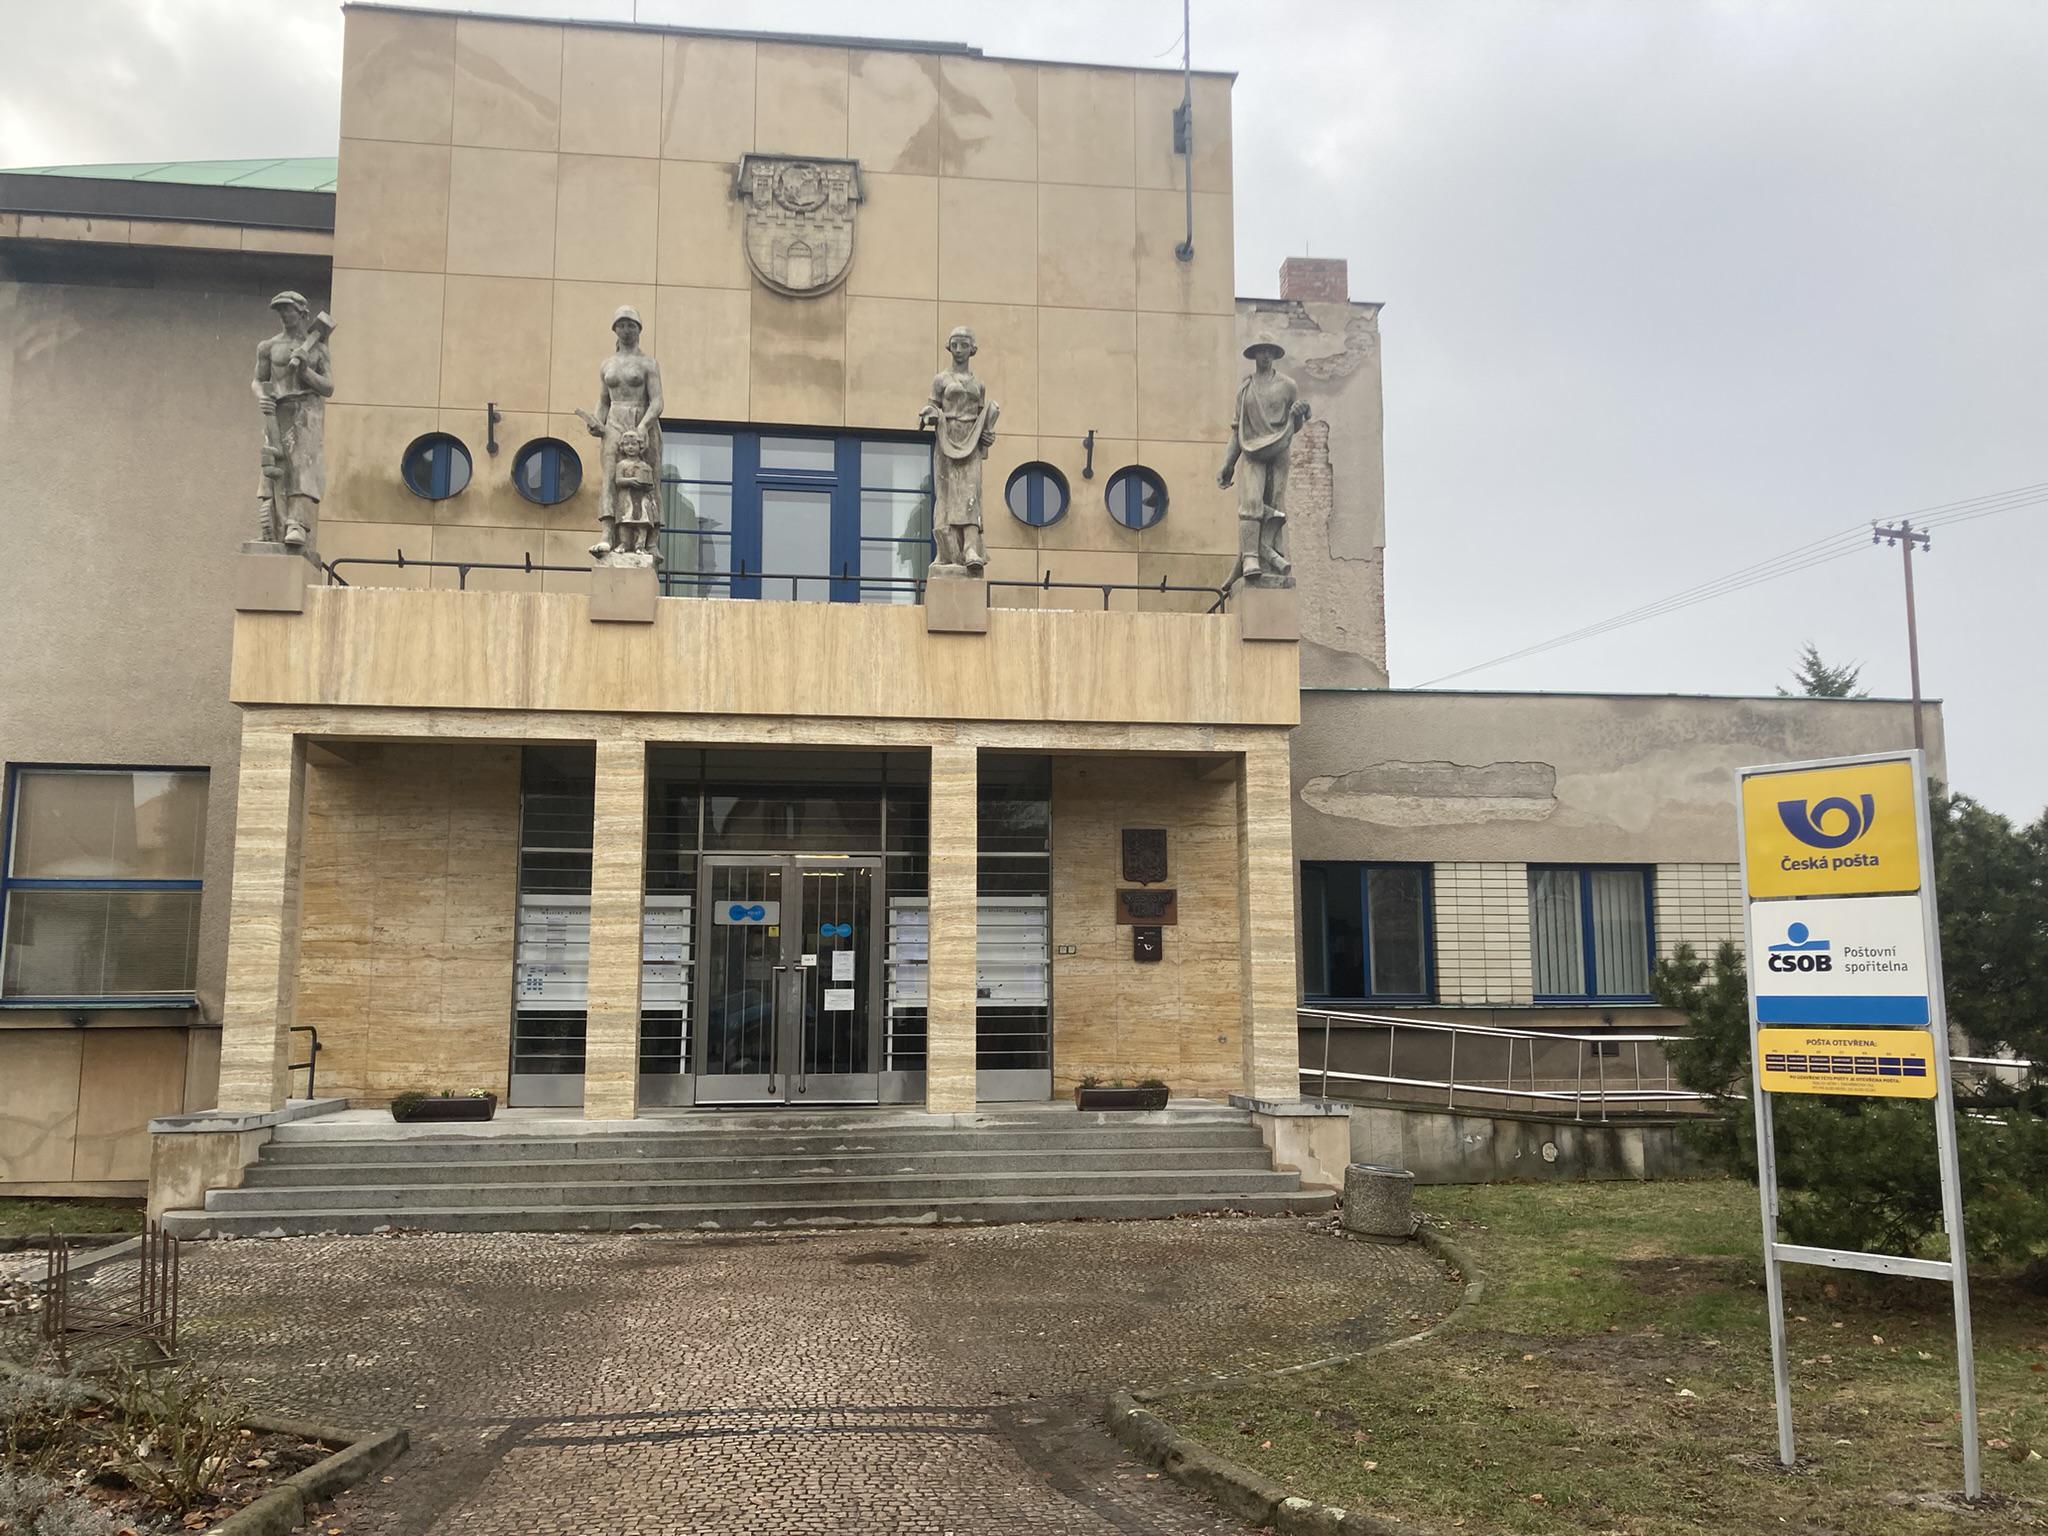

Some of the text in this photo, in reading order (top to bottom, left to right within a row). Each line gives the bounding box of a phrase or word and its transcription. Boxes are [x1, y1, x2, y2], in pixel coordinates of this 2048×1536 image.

[1781, 853, 1879, 871] Česká pošta
[1844, 945, 1896, 957] Poštovní
[1768, 953, 1832, 972] ČSOB
[1845, 960, 1908, 974] spořitelna
[1806, 1038, 1831, 1046] POŠTA
